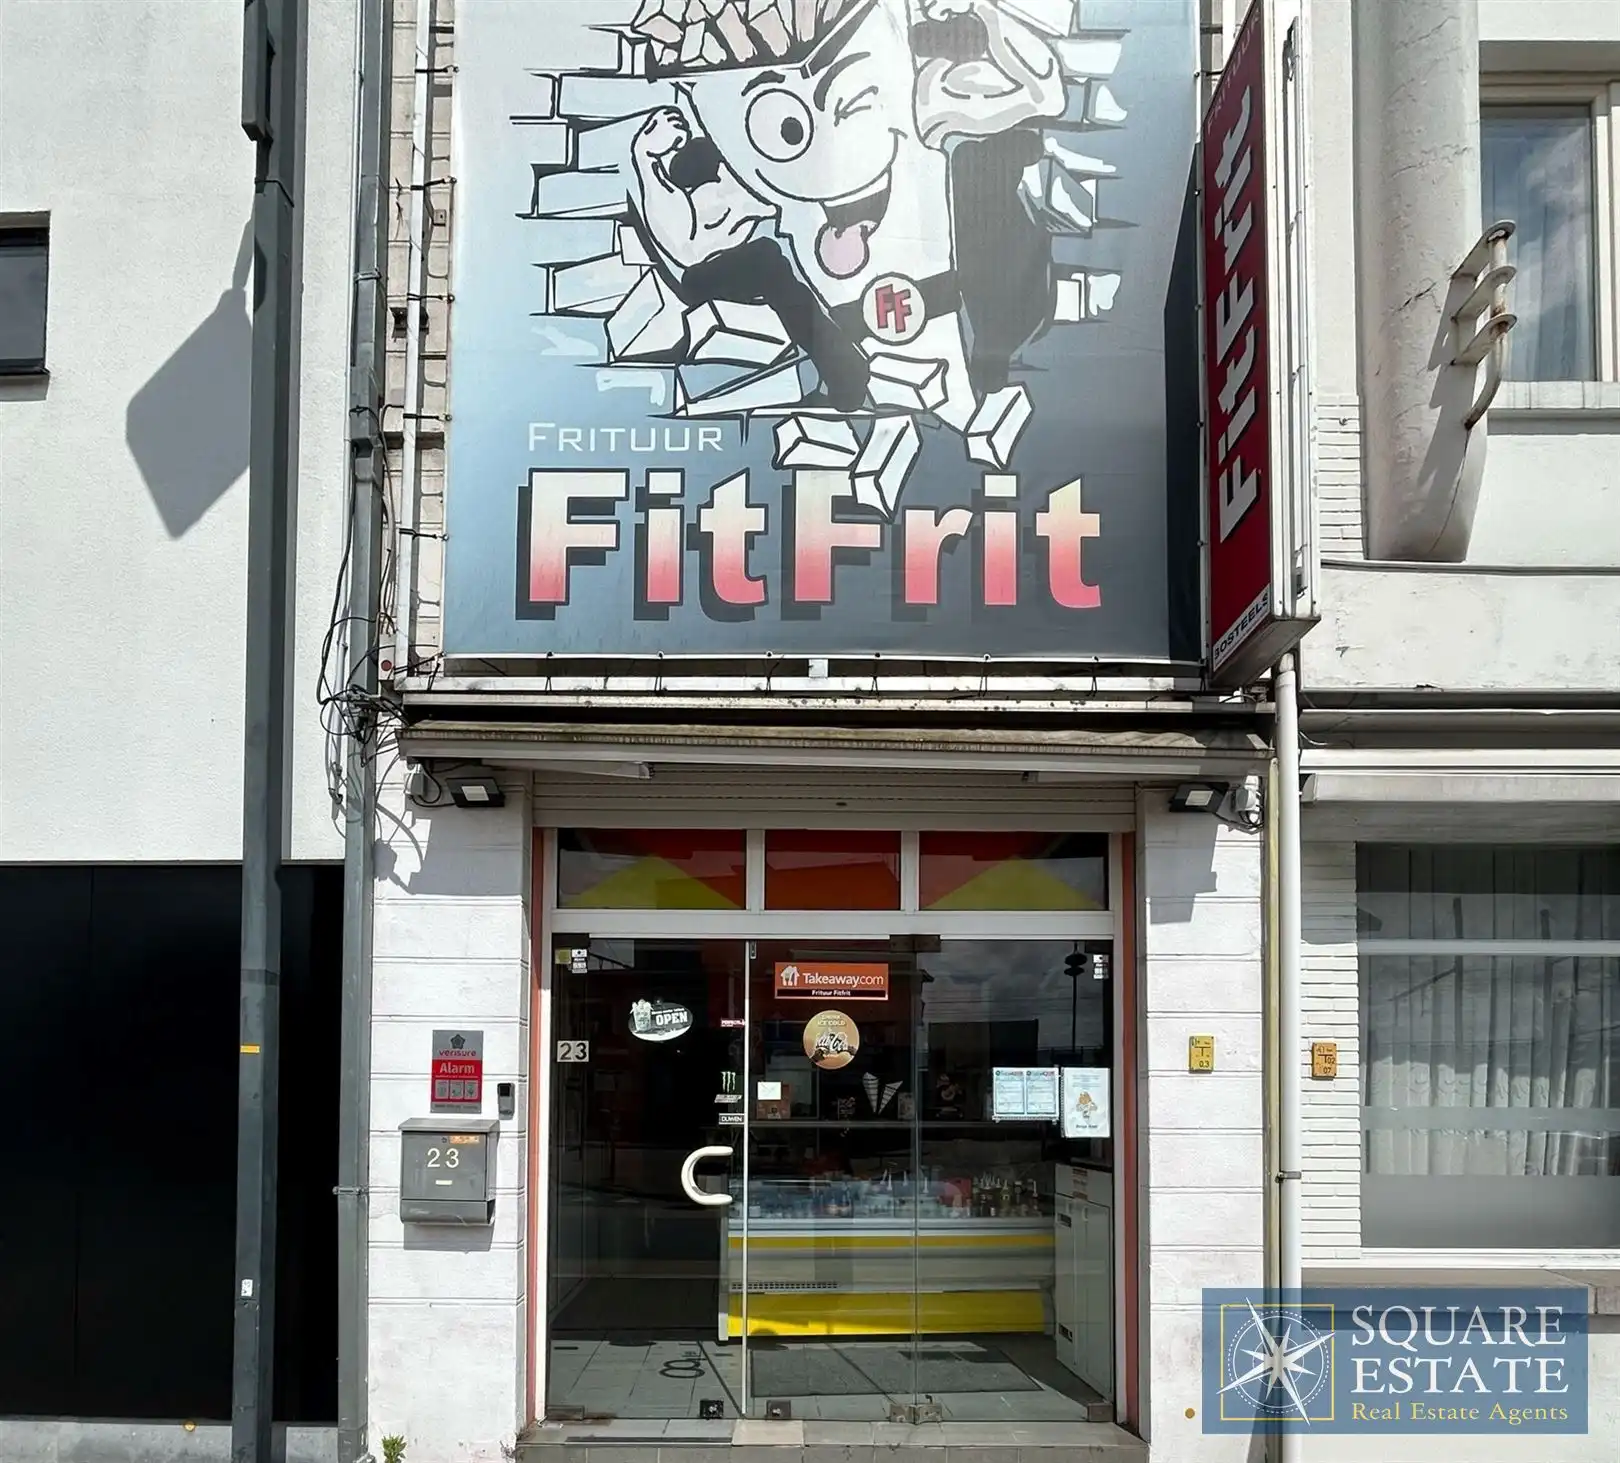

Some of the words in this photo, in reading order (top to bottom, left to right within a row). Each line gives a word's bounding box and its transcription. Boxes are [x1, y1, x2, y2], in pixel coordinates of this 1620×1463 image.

[1213, 84, 1259, 544] FitFrit
[528, 422, 724, 452] FRITUUR
[527, 467, 1103, 608] FitFrit
[802, 972, 884, 988] Takeaway.com
[655, 1011, 688, 1026] OPEN
[439, 1049, 477, 1057] verisure
[560, 1042, 587, 1060] 23
[440, 1062, 475, 1074] Alarm
[427, 1147, 460, 1168] 23
